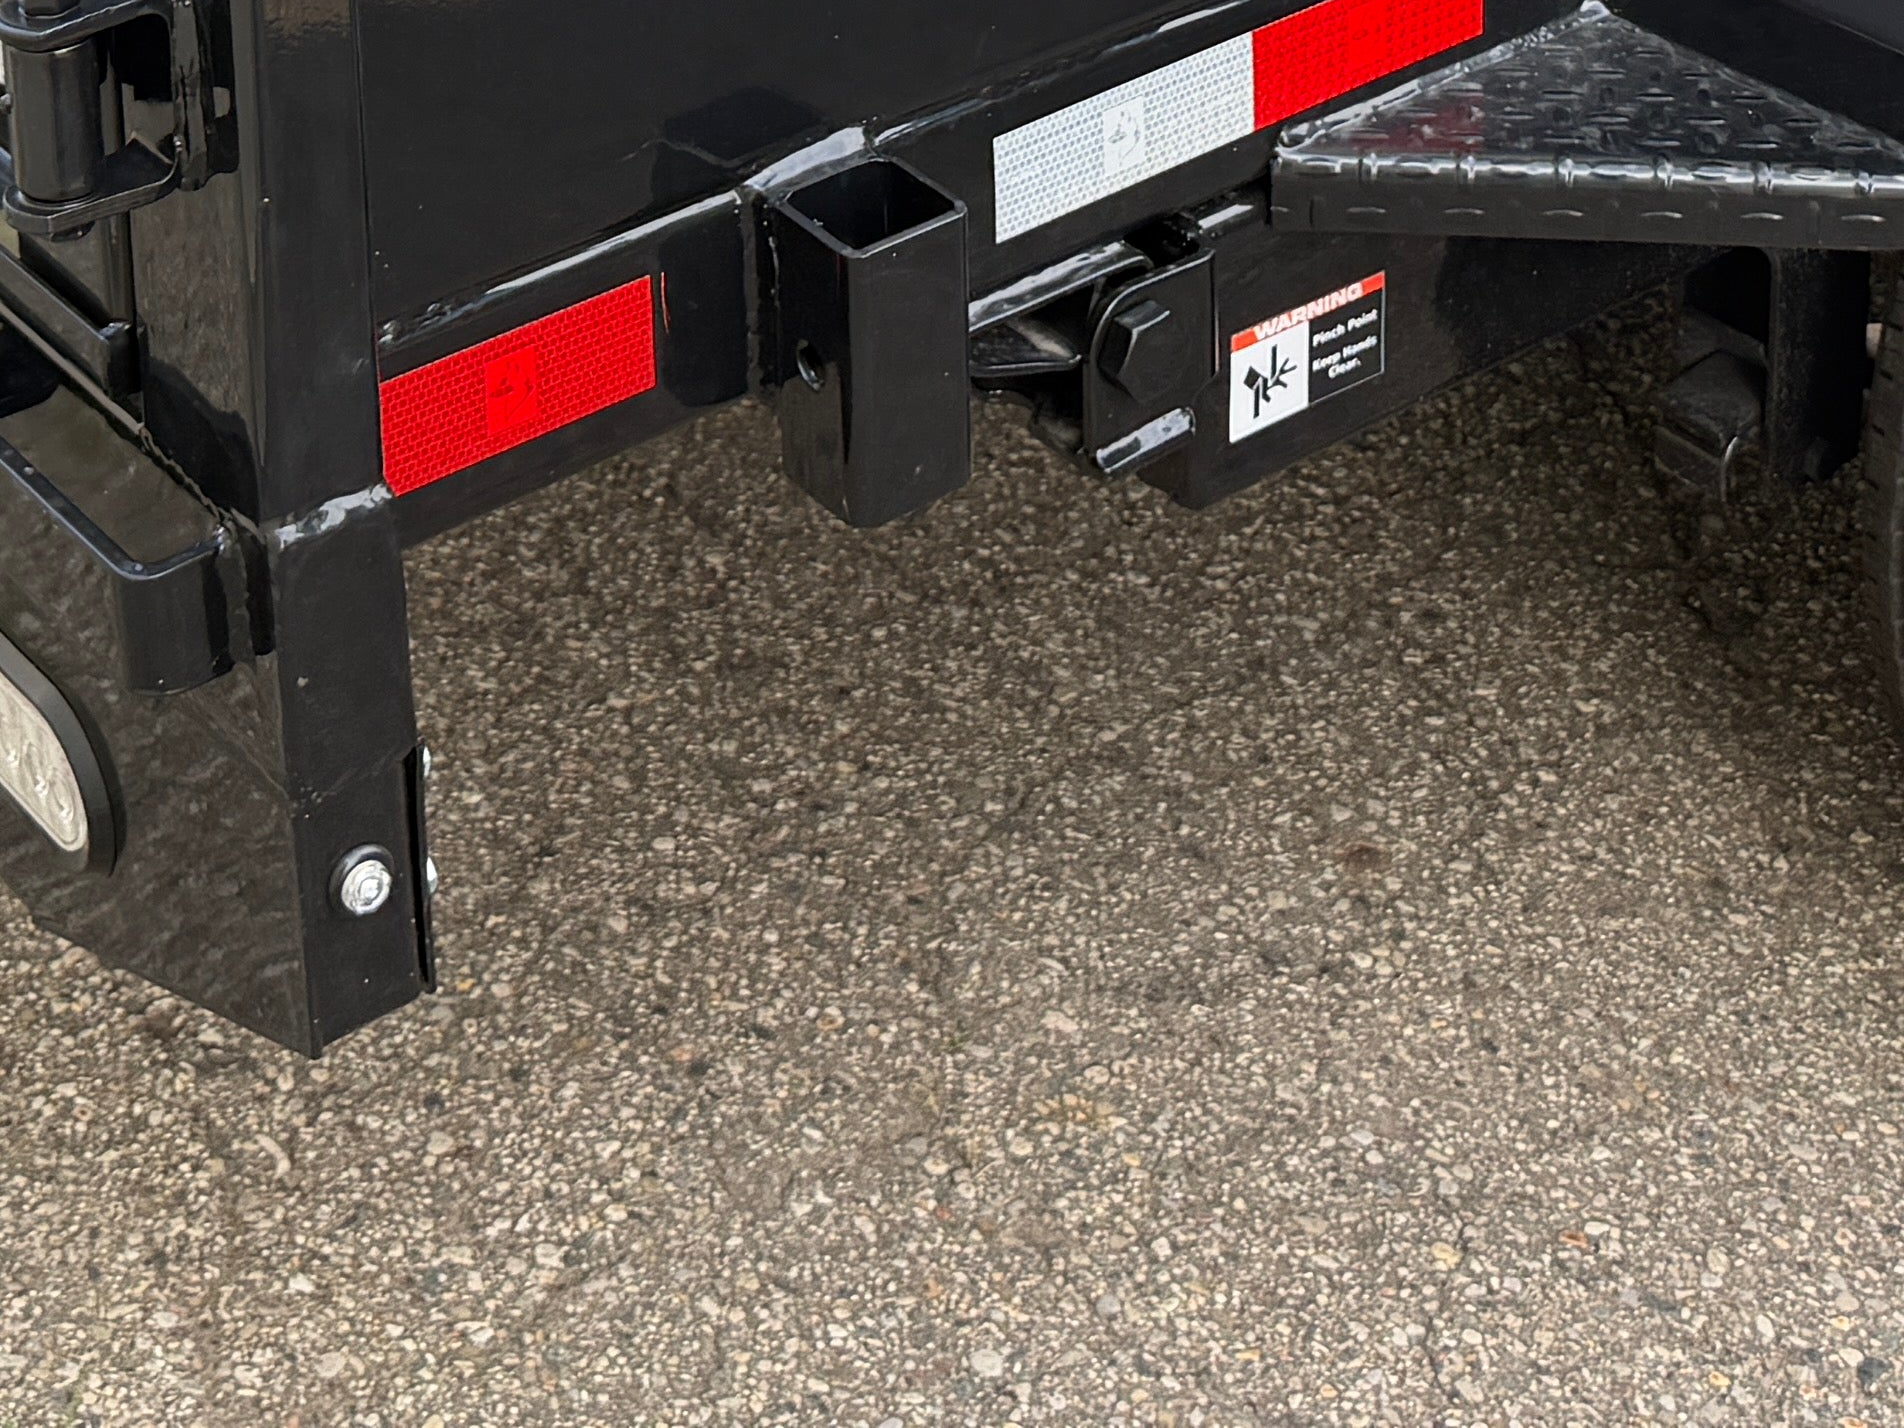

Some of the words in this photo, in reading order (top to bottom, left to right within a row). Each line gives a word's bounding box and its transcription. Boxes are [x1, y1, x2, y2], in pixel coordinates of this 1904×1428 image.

[1253, 282, 1363, 340] WARNING
[1312, 324, 1346, 347] Pinch
[1347, 308, 1378, 332] Point
